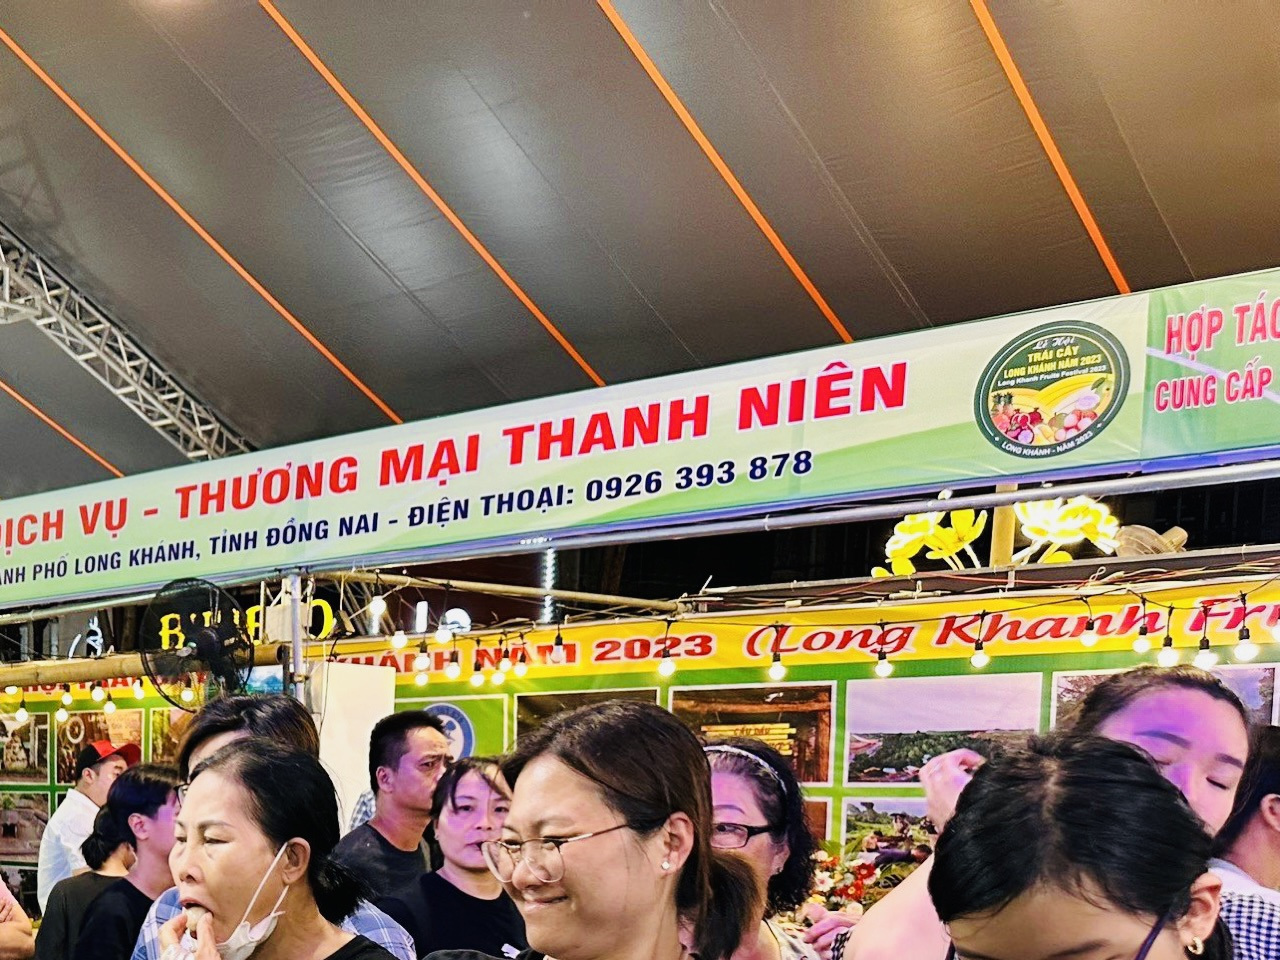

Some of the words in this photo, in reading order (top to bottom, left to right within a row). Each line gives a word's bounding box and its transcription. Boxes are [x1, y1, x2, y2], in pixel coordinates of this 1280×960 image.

[1028, 348, 1053, 362] TRÁI
[1056, 345, 1080, 358] CÂY
[1165, 306, 1223, 361] HỢP
[1004, 366, 1026, 379] LONG
[1028, 361, 1057, 375] KHÁNH
[1058, 356, 1079, 369] NĂM
[1080, 354, 1102, 365] 2023
[1016, 375, 1038, 384] Khanh
[1061, 368, 1089, 377] Festival
[1155, 375, 1217, 411] CUNG
[1225, 357, 1272, 403] CẤP
[79, 498, 127, 538] VỤ
[175, 456, 357, 519] THƯƠNG
[380, 433, 479, 486] MẠI
[503, 394, 709, 465] THANH
[738, 361, 907, 430] NIÊN
[1001, 441, 1022, 454] LONG
[1023, 446, 1050, 456] KHÁNH
[1056, 440, 1075, 453] NĂM
[1075, 431, 1094, 446] 2023
[32, 553, 69, 580] PHỐ
[74, 551, 121, 575] LONG
[129, 540, 201, 568] KHÁNH,
[209, 529, 257, 554] TỈNH
[266, 517, 328, 546] ĐỒNG
[338, 512, 378, 537] NAI
[407, 496, 469, 530] ĐIỆN
[480, 484, 573, 516] THOẠI:
[585, 470, 662, 501] 0926
[675, 461, 736, 490] 393
[748, 449, 813, 479] 878
[594, 635, 713, 661] 2023
[746, 624, 915, 656] (Long
[935, 604, 1165, 645] Khanh
